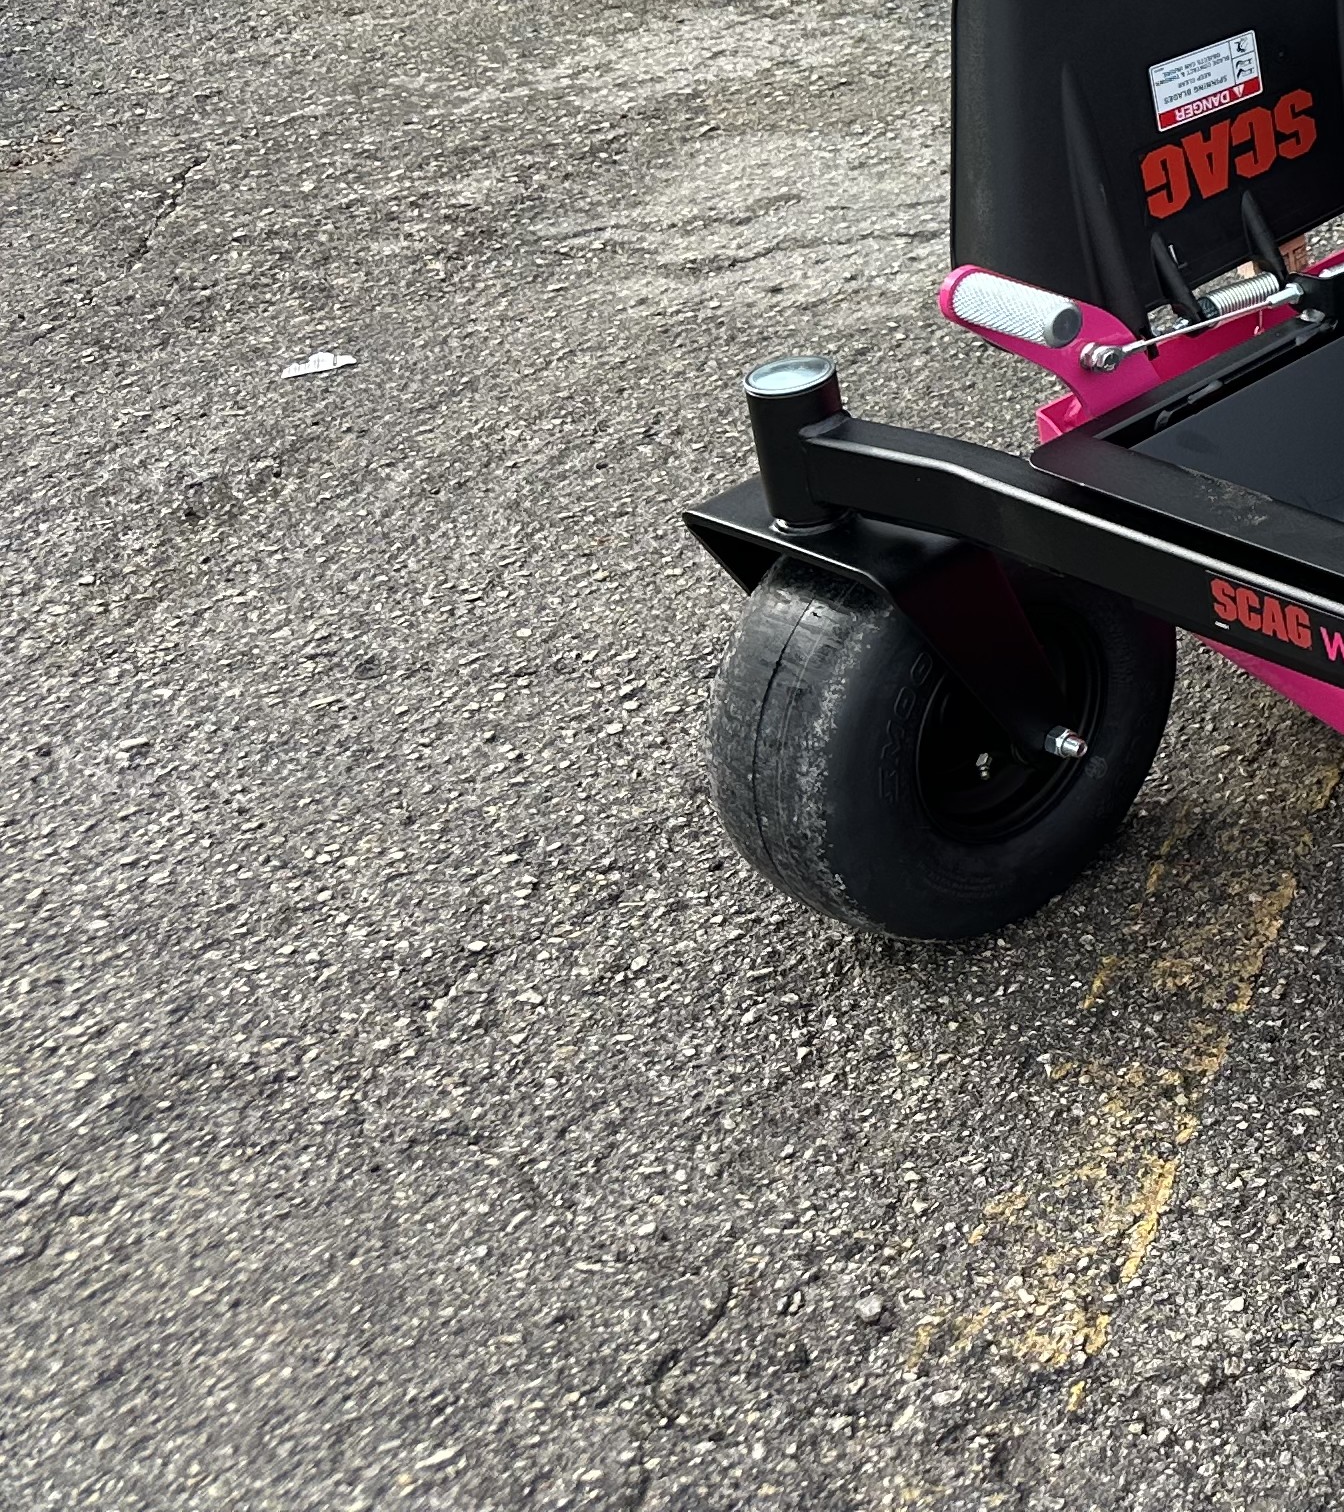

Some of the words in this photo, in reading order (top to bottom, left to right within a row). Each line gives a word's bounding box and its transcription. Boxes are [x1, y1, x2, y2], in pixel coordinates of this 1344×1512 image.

[1174, 90, 1231, 121] DANGER
[1140, 88, 1317, 220] SCAG
[1209, 578, 1313, 650] SCAG
